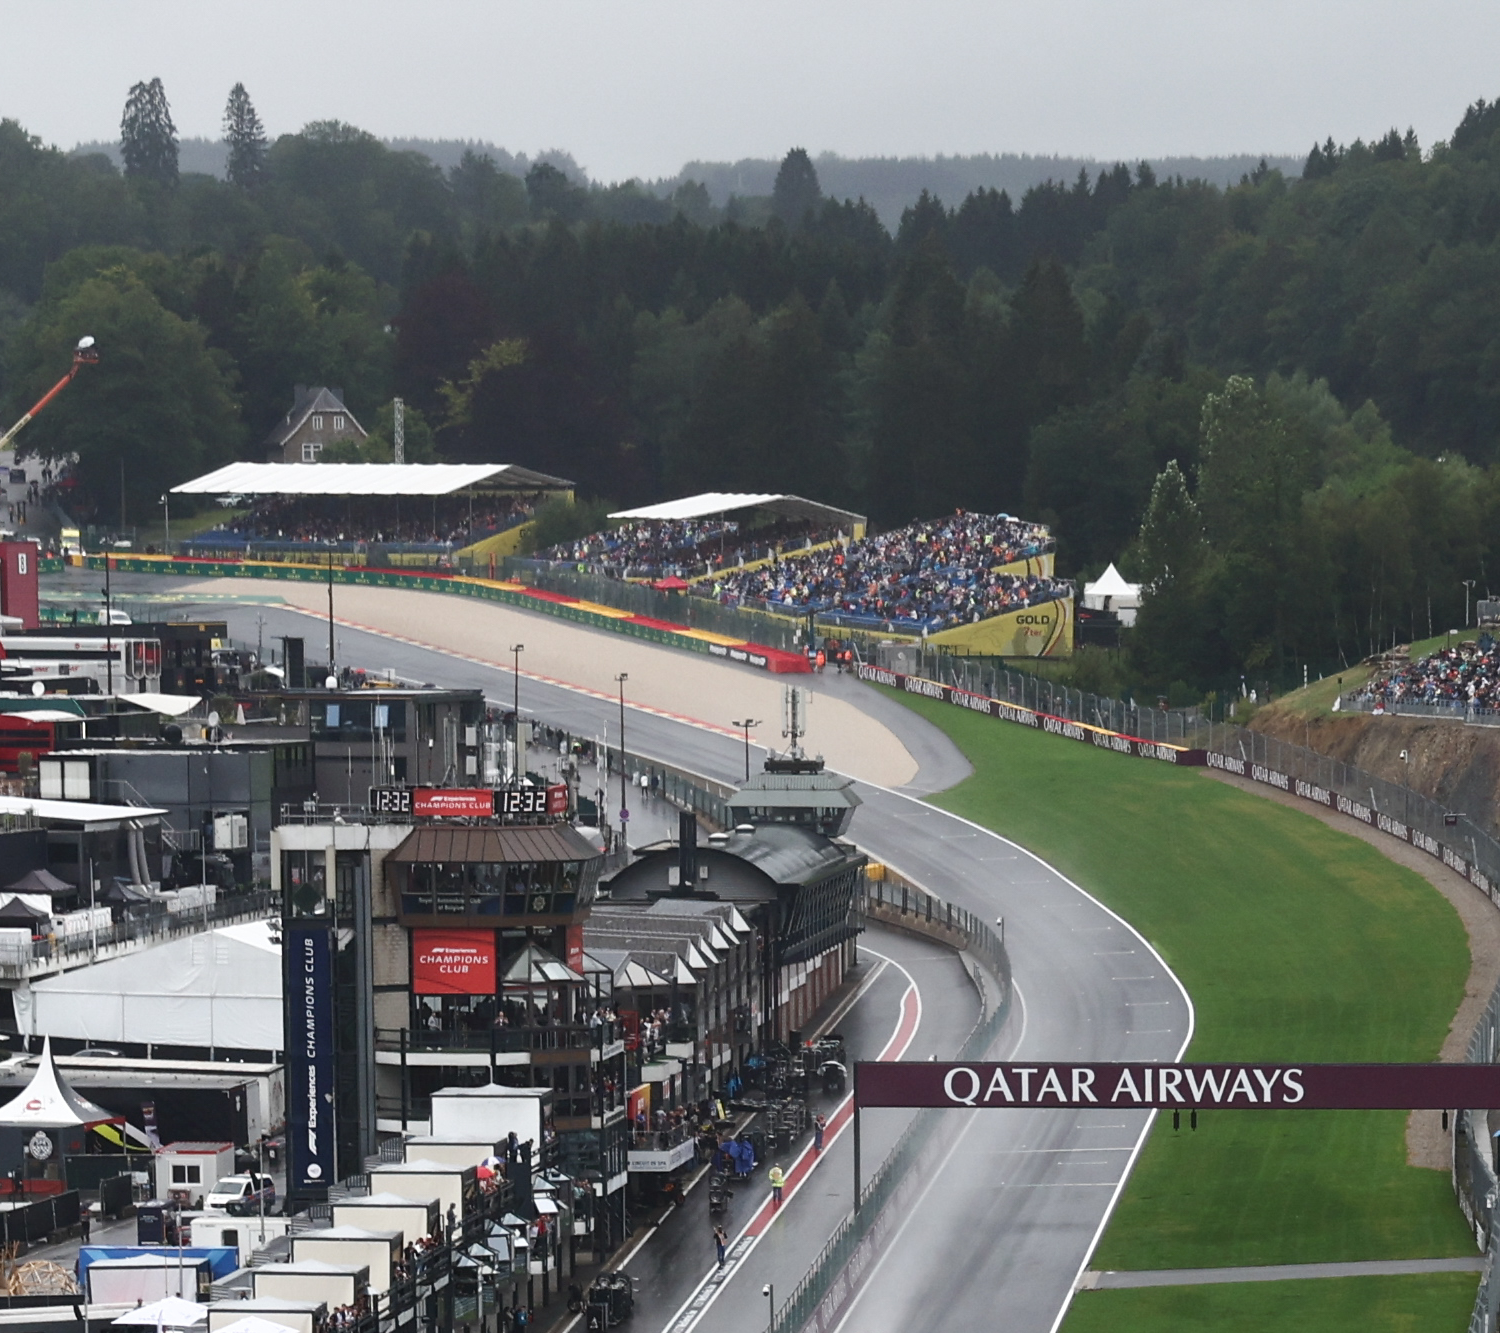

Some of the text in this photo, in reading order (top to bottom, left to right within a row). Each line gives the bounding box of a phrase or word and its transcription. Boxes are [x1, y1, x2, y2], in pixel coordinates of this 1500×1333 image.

[1016, 615, 1050, 625] GOLD
[503, 791, 546, 812] 12:32
[304, 938, 314, 973] CLUB
[420, 955, 488, 964] CHAMPIONS
[440, 965, 469, 973] CLUB
[305, 976, 316, 1058] CHAMPIONS
[307, 1064, 318, 1129] Experiences
[943, 1068, 1304, 1106] QATAR AIRWAYS
